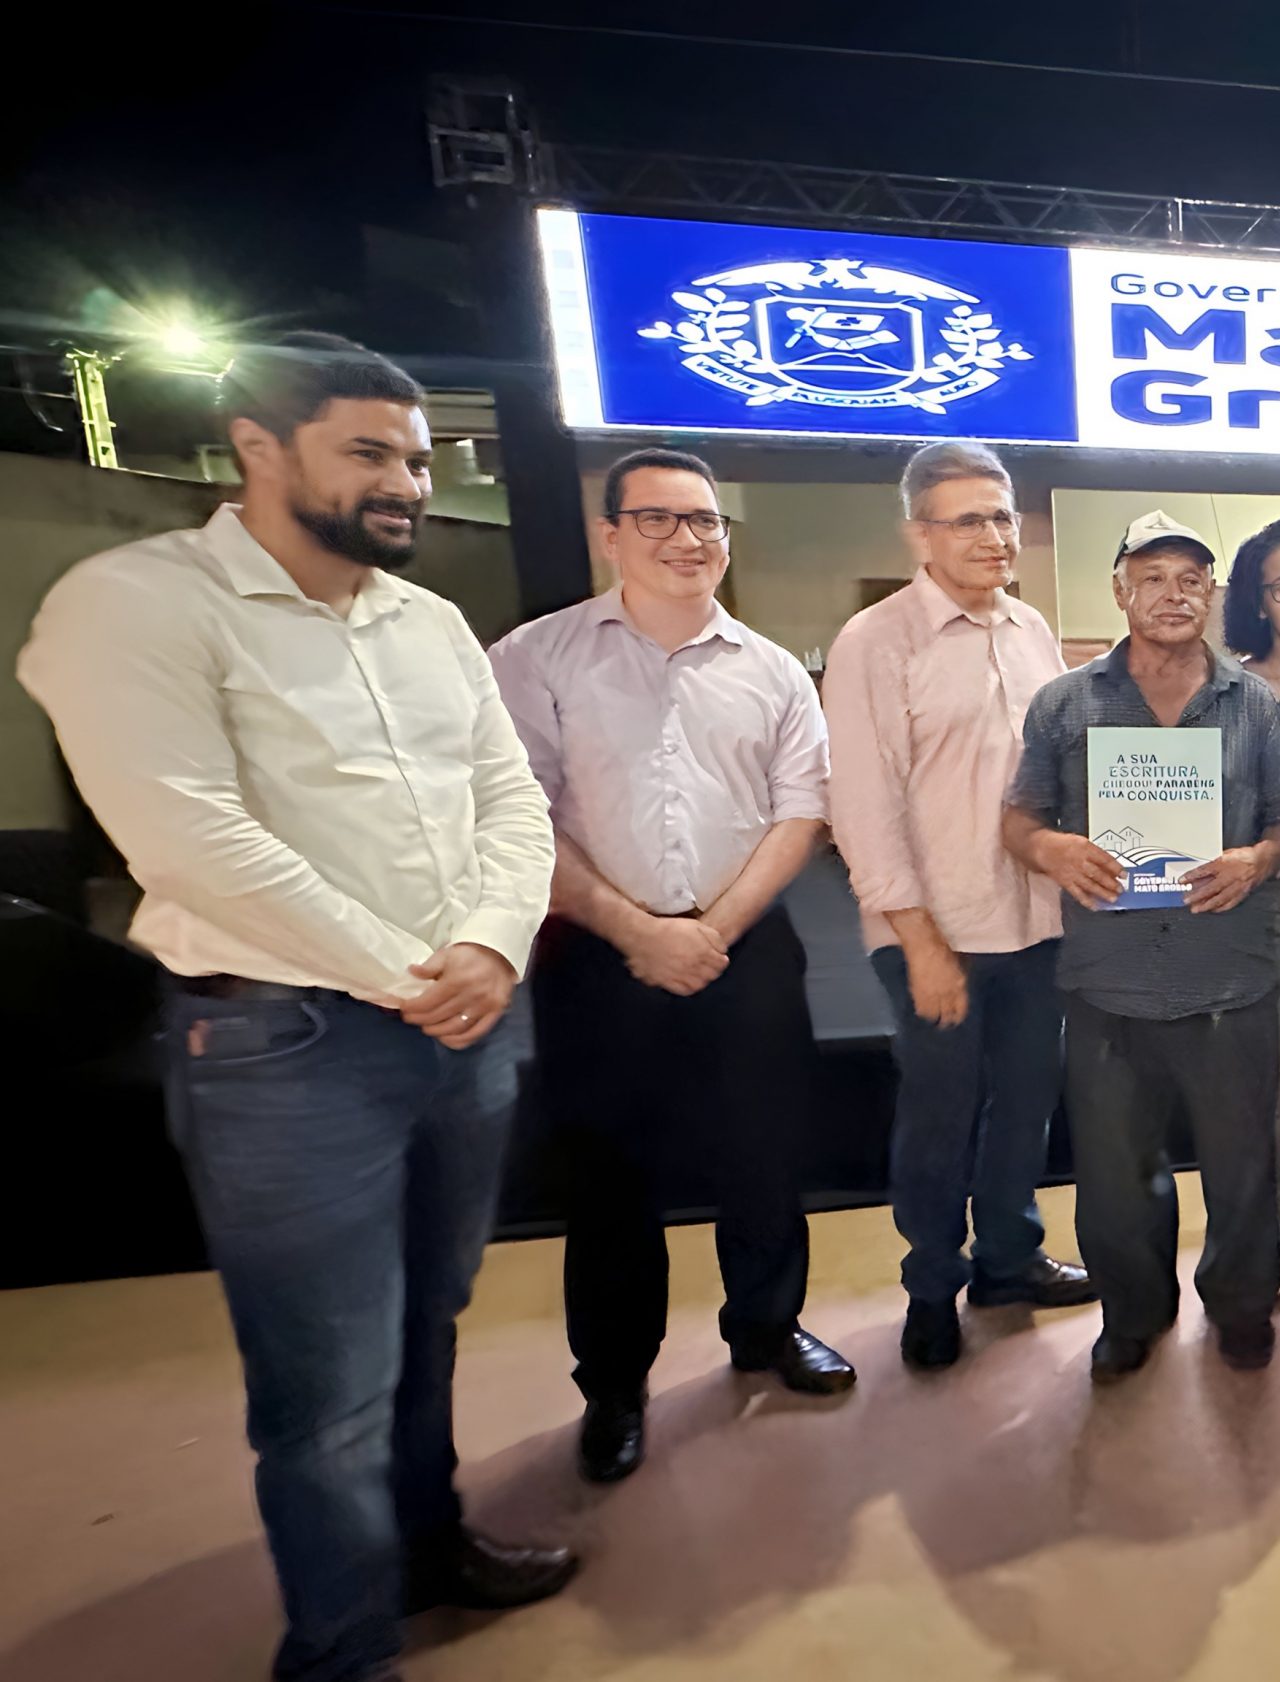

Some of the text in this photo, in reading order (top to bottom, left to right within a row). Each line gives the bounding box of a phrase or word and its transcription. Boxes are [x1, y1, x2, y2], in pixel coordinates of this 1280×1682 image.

[1117, 754, 1158, 764] A SUA
[1108, 765, 1199, 778] ESCRITURA
[1127, 790, 1214, 801] CONQUISTA.
